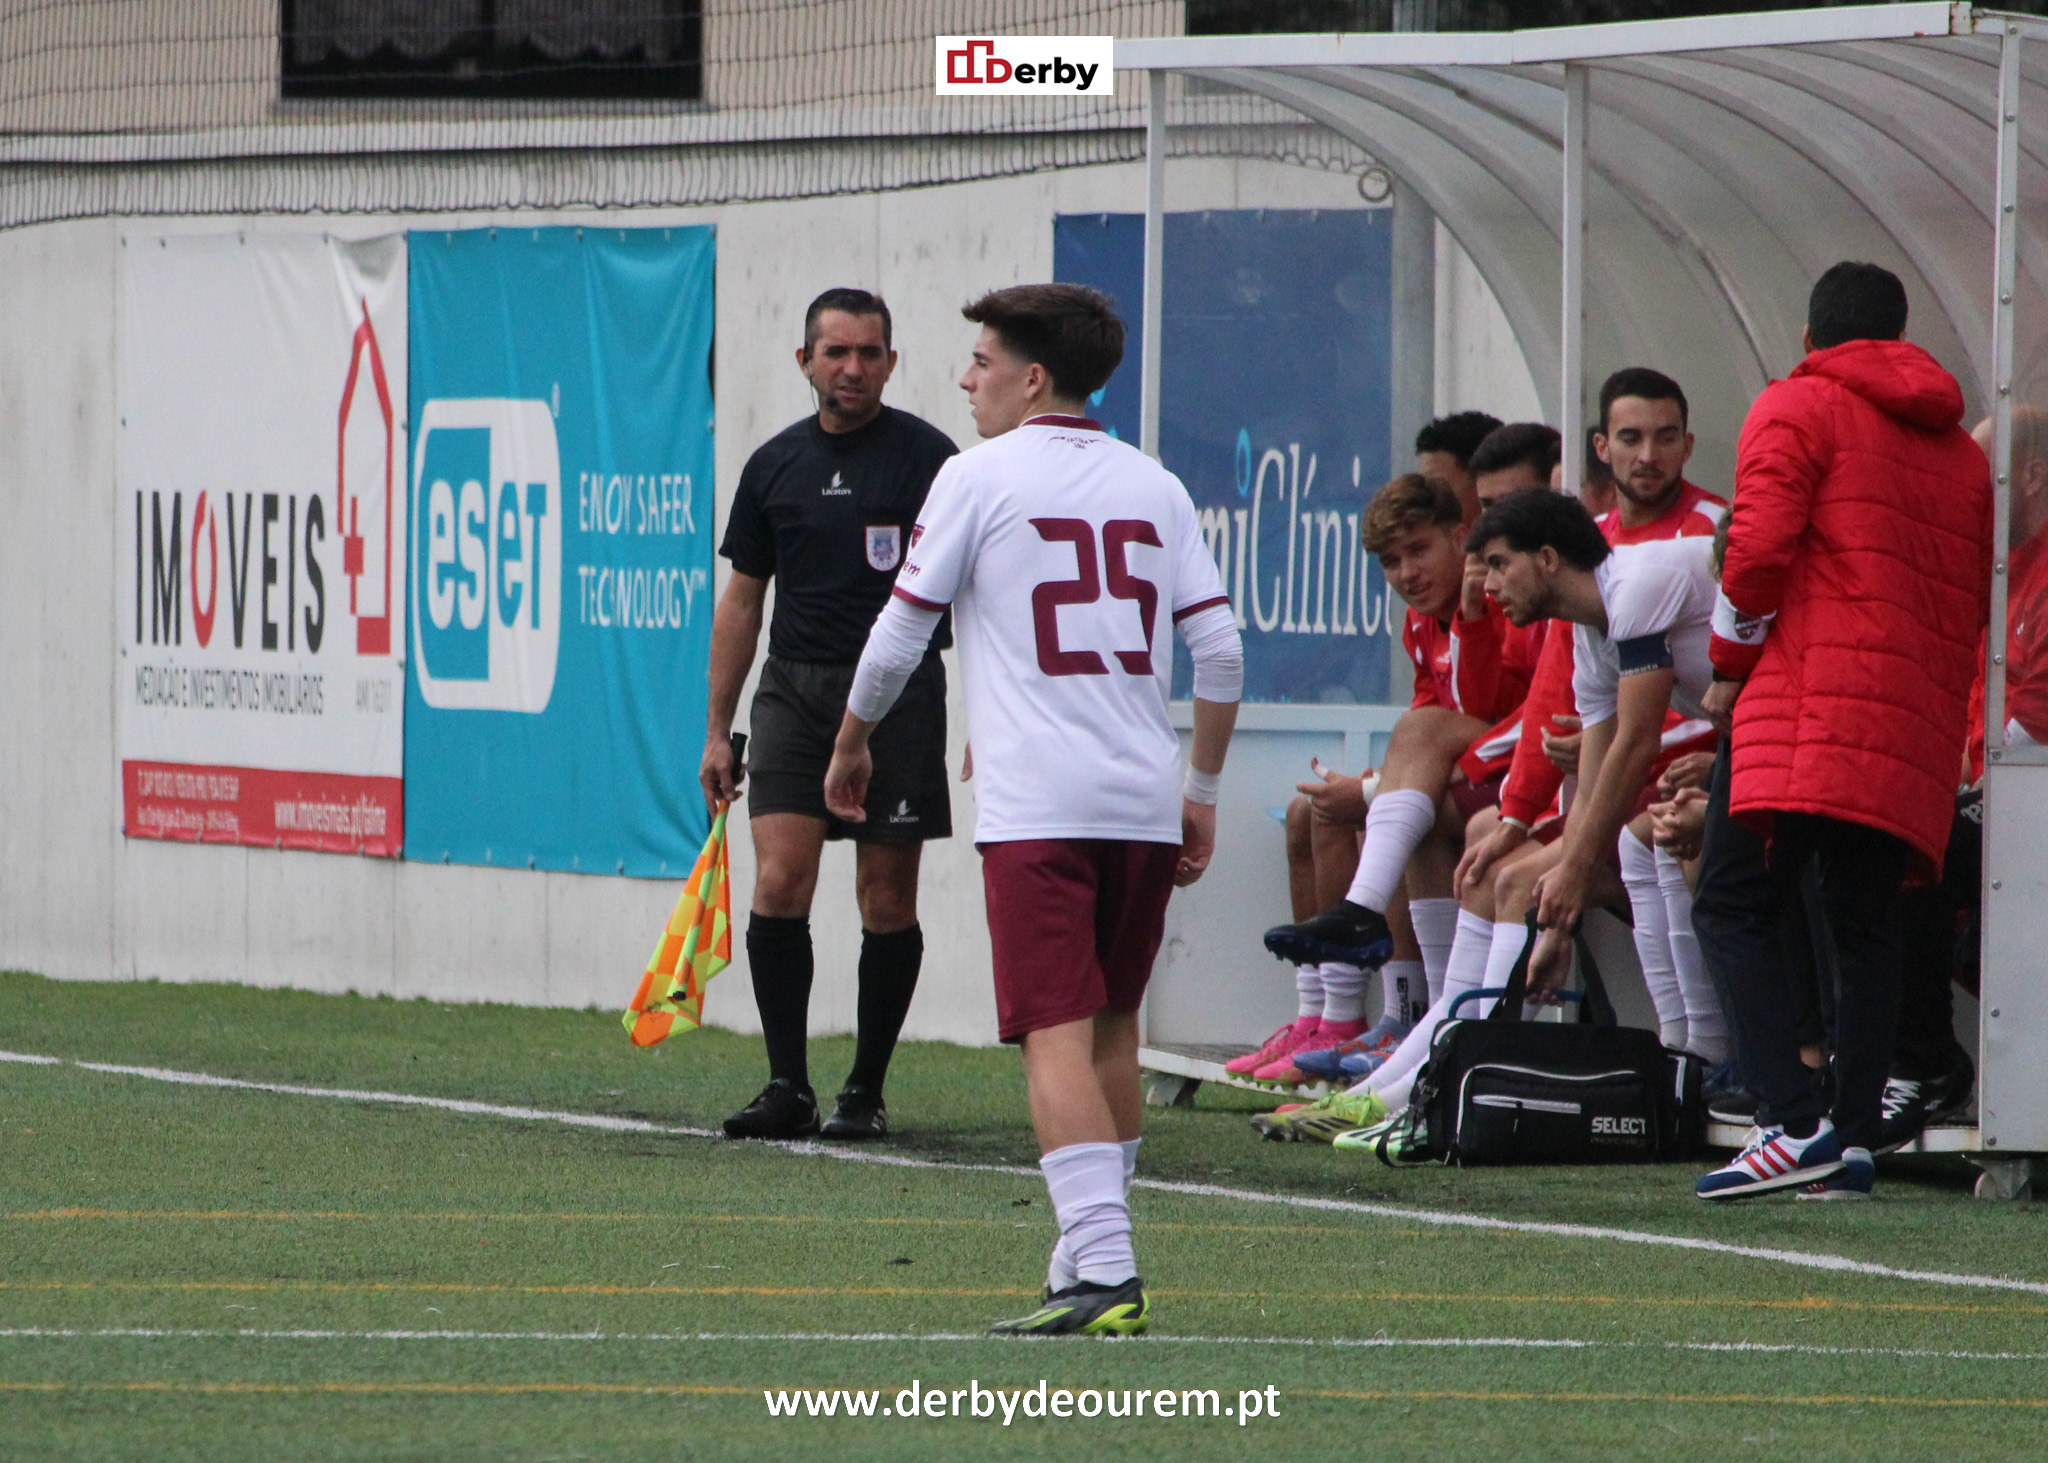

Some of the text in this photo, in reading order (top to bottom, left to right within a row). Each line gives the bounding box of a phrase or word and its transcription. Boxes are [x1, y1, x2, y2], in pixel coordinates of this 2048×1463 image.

[637, 473, 696, 535] SAFER
[1028, 517, 1164, 677] 25
[1591, 1116, 1646, 1135] SELECT
